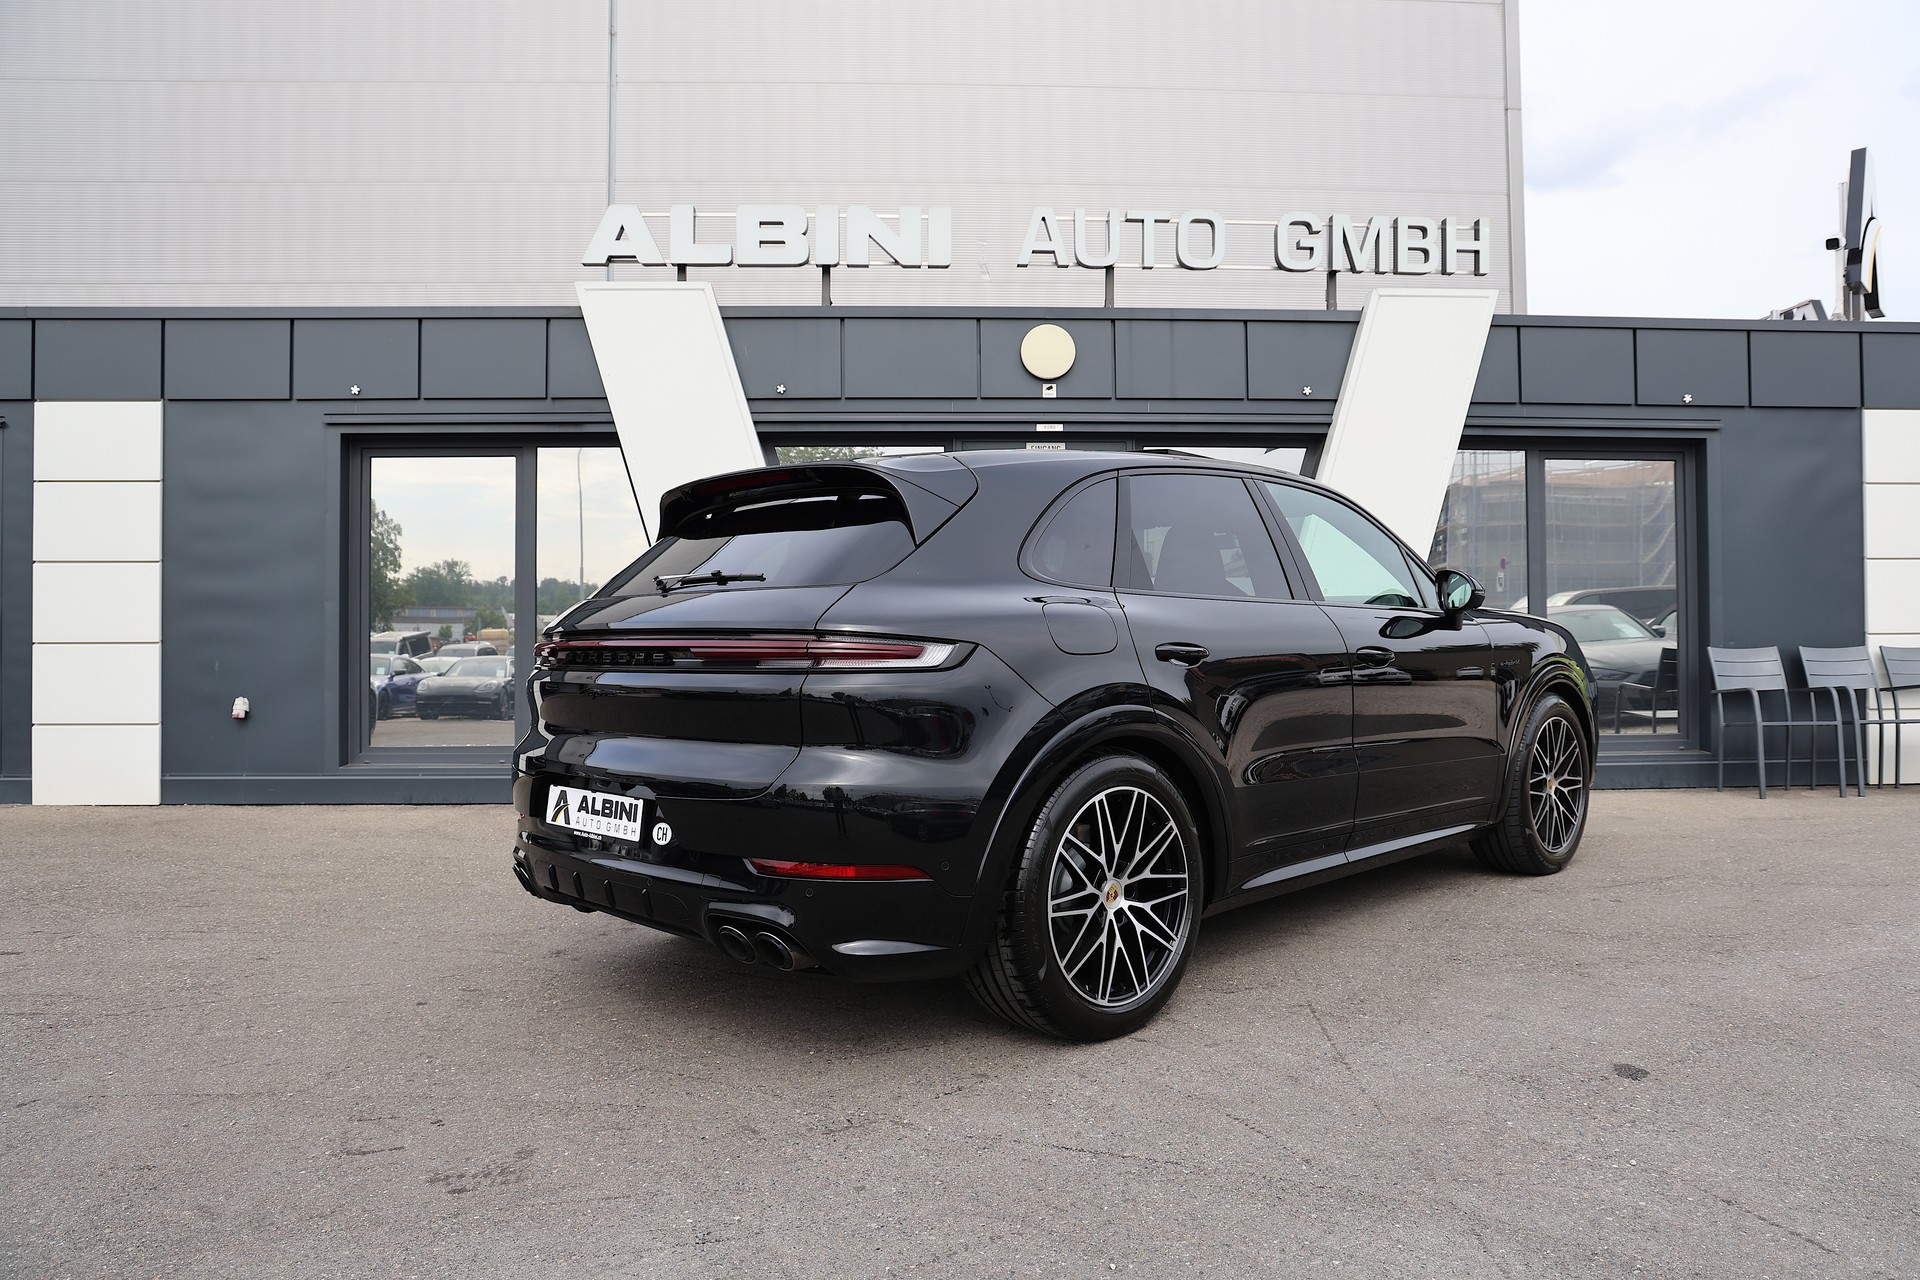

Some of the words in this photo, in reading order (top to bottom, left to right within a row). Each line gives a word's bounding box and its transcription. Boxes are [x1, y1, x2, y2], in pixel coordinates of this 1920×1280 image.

[581, 204, 951, 268] ALBINI
[1016, 206, 1226, 270] AUTO
[1274, 211, 1490, 276] GMBH
[577, 795, 638, 823] ALBINI
[575, 816, 602, 830] AUTO
[606, 822, 637, 837] GMBH
[656, 826, 668, 842] CH
